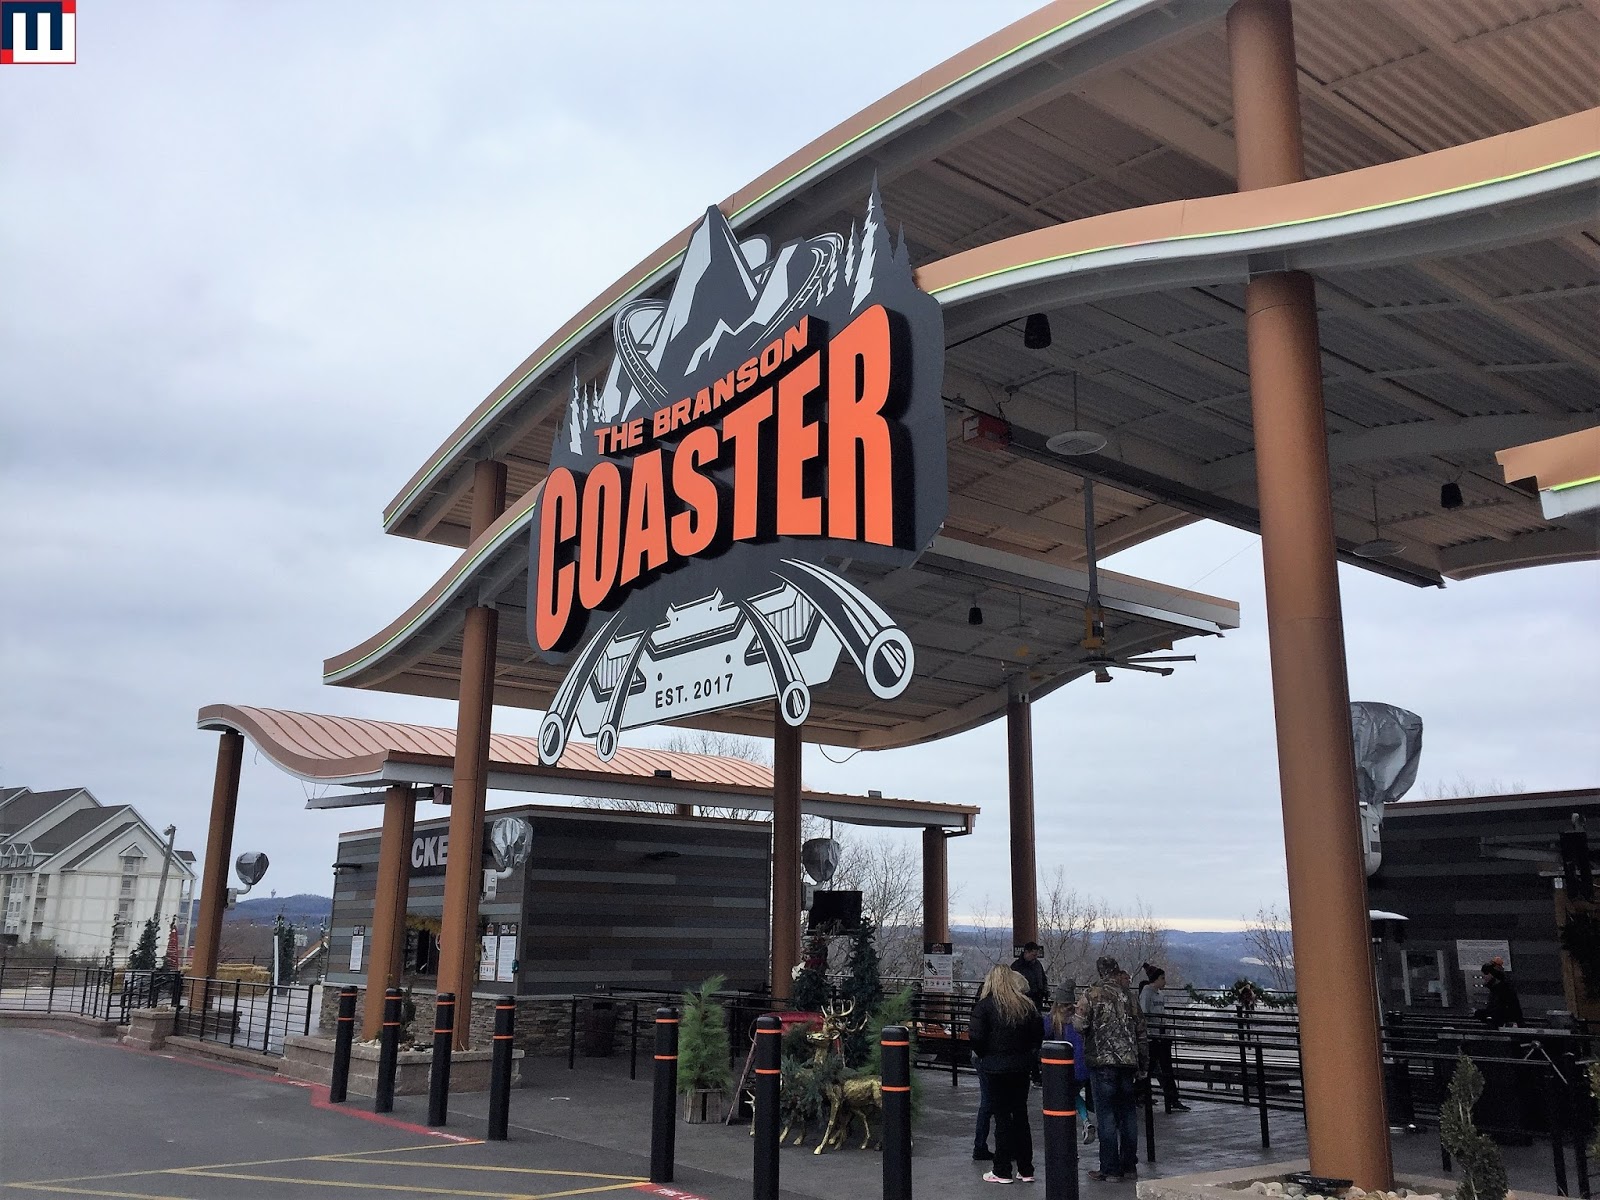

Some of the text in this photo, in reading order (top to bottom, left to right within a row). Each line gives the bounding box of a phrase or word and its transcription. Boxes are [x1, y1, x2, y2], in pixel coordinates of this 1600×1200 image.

[593, 314, 809, 455] THE BRANSON
[535, 303, 894, 651] COASTER
[655, 672, 734, 709] EST. 2017
